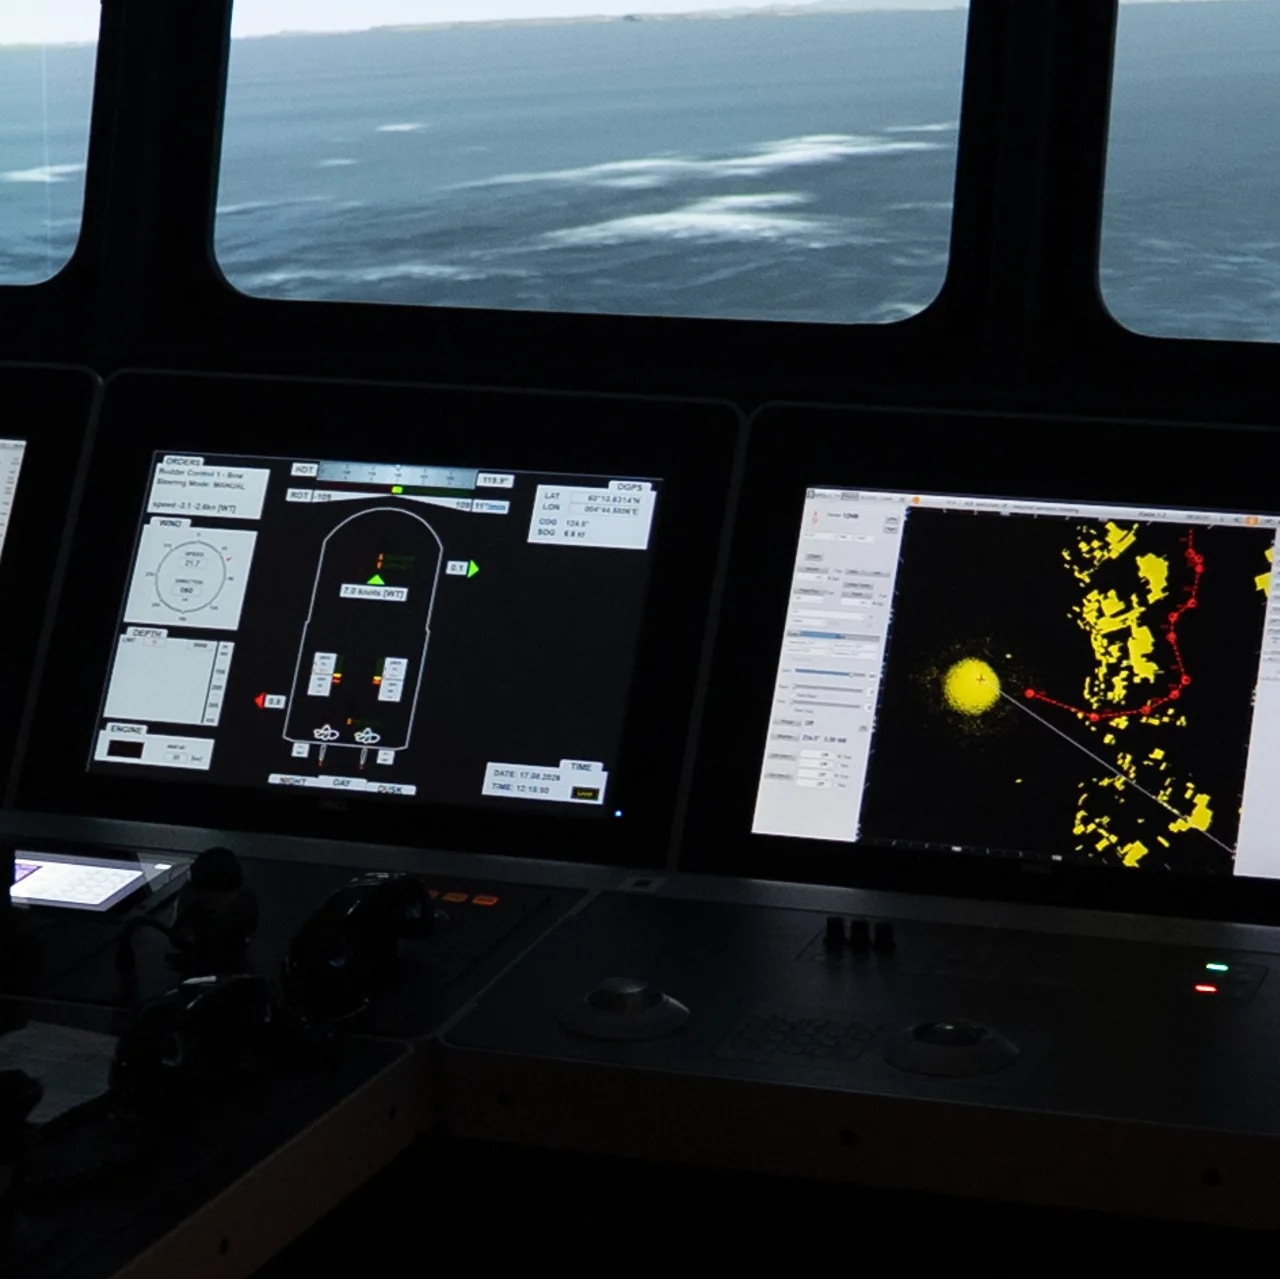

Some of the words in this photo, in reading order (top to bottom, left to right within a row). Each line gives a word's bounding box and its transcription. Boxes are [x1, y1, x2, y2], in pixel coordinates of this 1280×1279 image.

[166, 457, 201, 467] ORDERS
[159, 468, 185, 476] Rudder
[187, 469, 214, 478] Control
[294, 464, 316, 474] HDT
[156, 478, 187, 488] Steering
[617, 482, 643, 492] DGPS
[289, 490, 310, 500] ROT
[544, 492, 561, 501] LAT
[542, 503, 561, 511] LON
[159, 519, 183, 528] WIND
[538, 518, 558, 526] COG
[537, 528, 556, 537] SOG
[132, 628, 163, 639] DEPTH
[110, 724, 144, 735] ENGINE
[570, 762, 594, 773] TIME
[331, 778, 351, 788] DAY
[376, 784, 404, 794] DUSK
